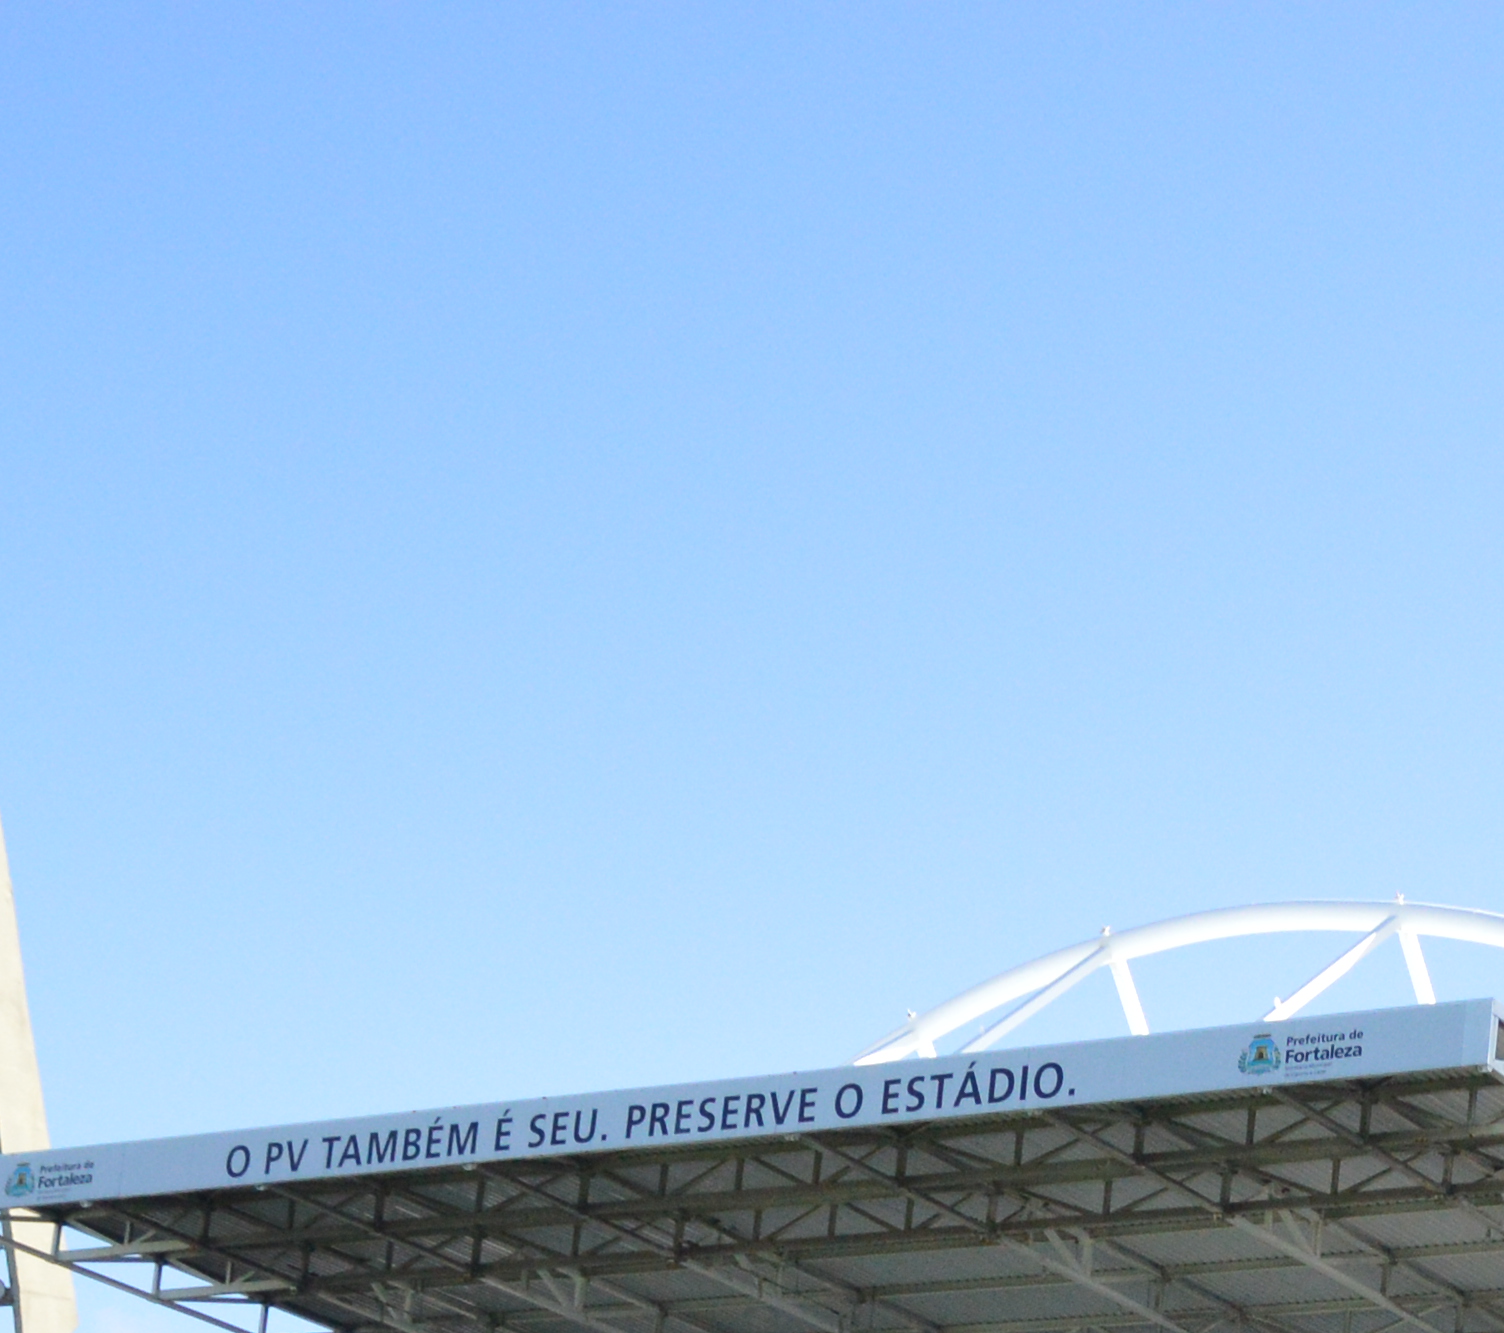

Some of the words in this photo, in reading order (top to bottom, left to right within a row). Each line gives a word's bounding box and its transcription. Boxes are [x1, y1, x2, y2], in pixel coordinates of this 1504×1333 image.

[1286, 1032, 1345, 1047] Prefeitura
[1349, 1029, 1364, 1040] de
[1285, 1044, 1363, 1064] Fortaleza
[226, 1145, 251, 1178] O
[264, 1139, 309, 1175] PV
[322, 1116, 479, 1169] TAMBÉM
[494, 1109, 514, 1152] É
[527, 1108, 607, 1149] SEU.
[625, 1087, 818, 1139] PRESERVE
[834, 1083, 864, 1119] O
[881, 1061, 1076, 1115] ESTÁDIO.
[38, 1173, 93, 1189] Fortaleza
